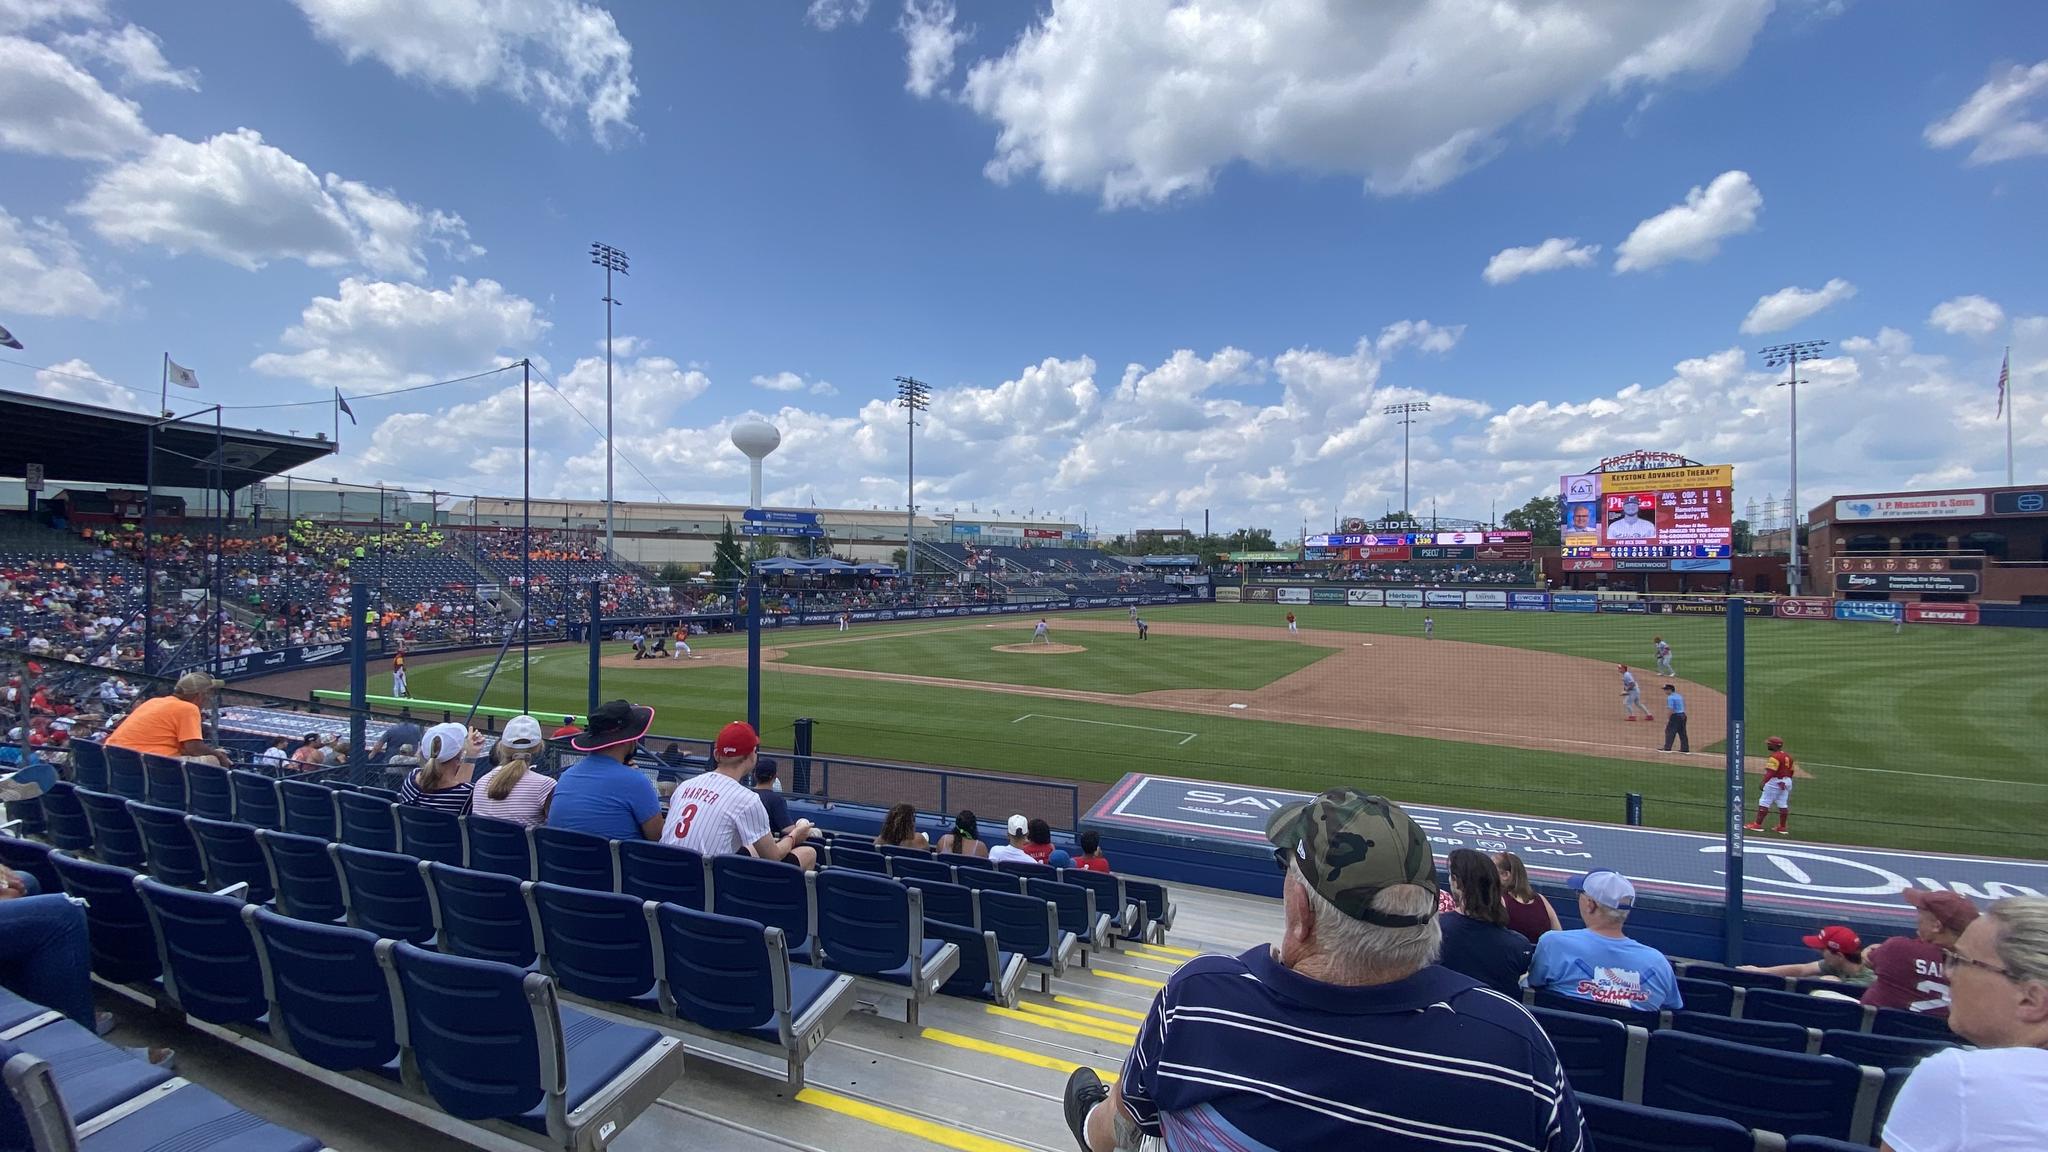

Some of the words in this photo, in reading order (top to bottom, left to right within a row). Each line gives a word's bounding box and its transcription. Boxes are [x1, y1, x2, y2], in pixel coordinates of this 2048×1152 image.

[1612, 473, 1646, 481] KEYSTONE
[1648, 470, 1685, 479] ADVANCED
[1687, 468, 1720, 477] THERAPY
[1894, 500, 1938, 509] Mascaro
[1949, 498, 1976, 507] Sons
[1366, 521, 1418, 530] SEIDEL
[1422, 548, 1440, 557] PSECU
[1562, 547, 1578, 557] 2-1
[1848, 574, 1878, 586] EnerSys
[1714, 604, 1761, 614] Unsity
[1920, 612, 1967, 620] LEVAN
[681, 786, 720, 806] HARPER
[674, 803, 698, 839] 3
[1733, 795, 1741, 849] AXCESS
[1452, 820, 1578, 839] AUTO
[1453, 827, 1583, 845] GROUP
[810, 1028, 822, 1044] 11
